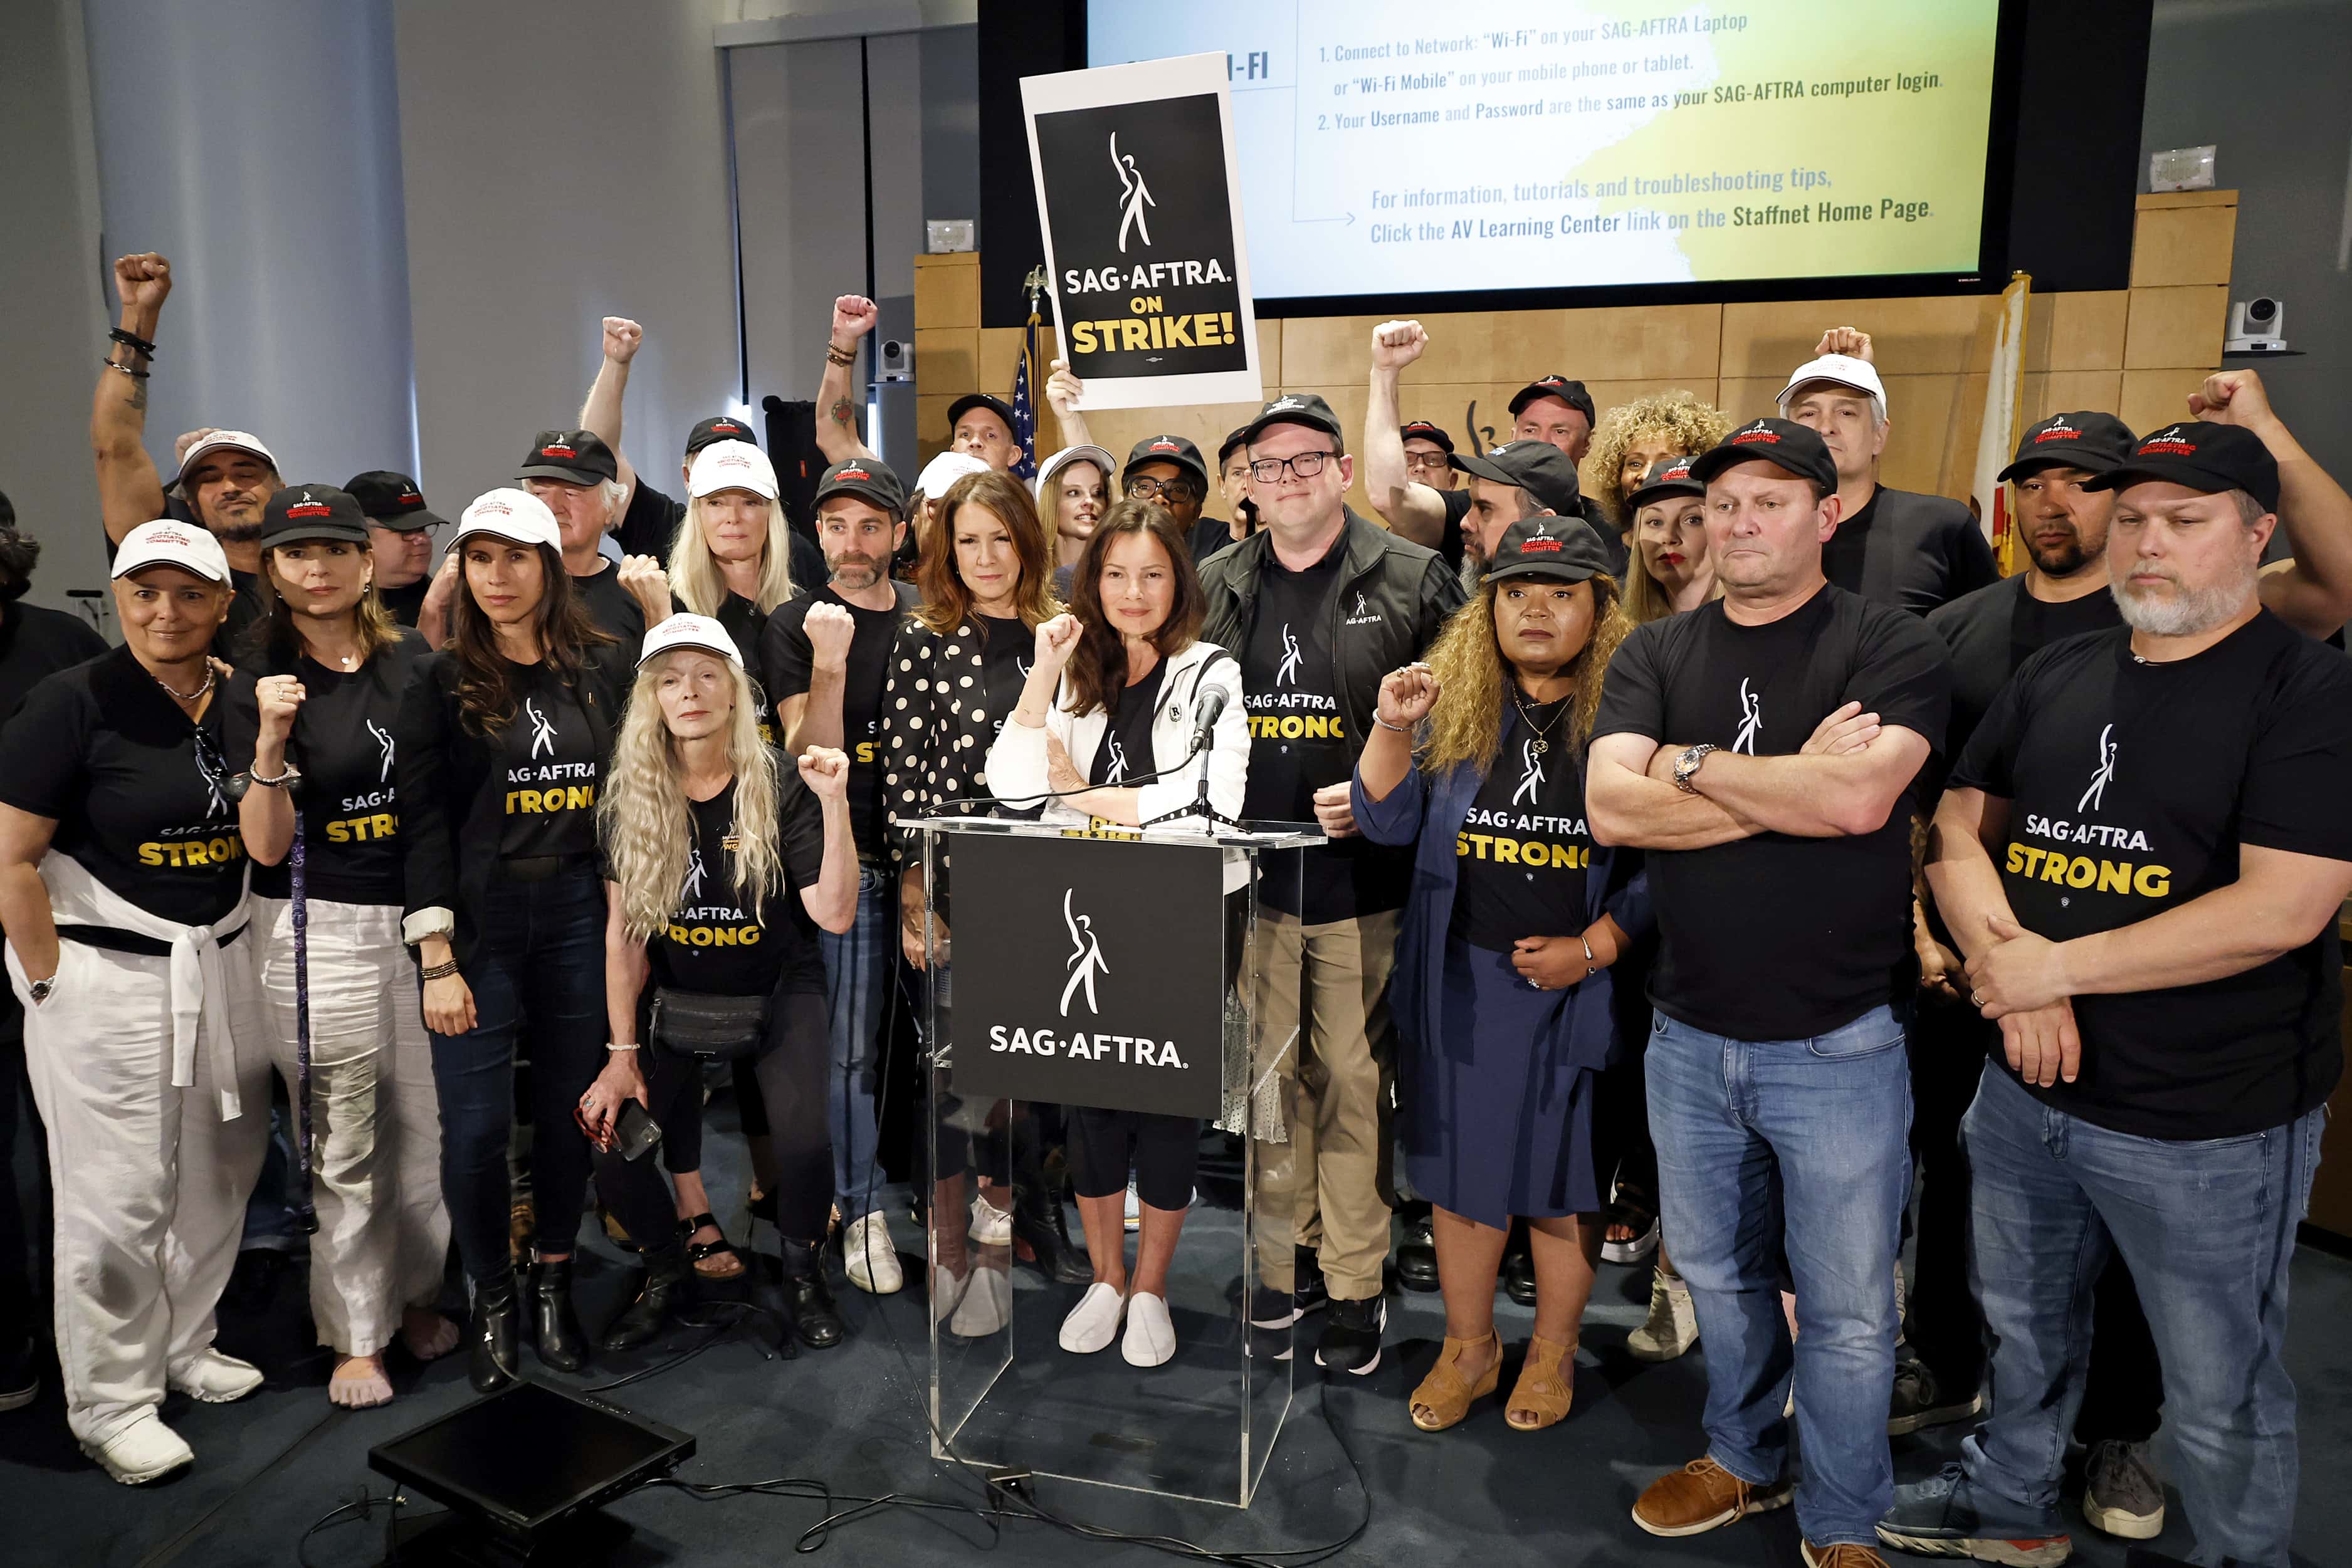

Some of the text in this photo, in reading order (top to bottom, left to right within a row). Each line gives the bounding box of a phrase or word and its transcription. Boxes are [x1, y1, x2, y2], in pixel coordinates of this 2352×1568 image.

[1319, 46, 1330, 63] 1.
[1335, 42, 1390, 62] Connect
[1396, 41, 1410, 56] to
[1414, 34, 1478, 56] Network:
[1540, 30, 1558, 46] on
[1563, 28, 1595, 47] your
[1601, 15, 1689, 40] SAG-AFTRA
[1694, 13, 1748, 34] Laptop
[1227, 51, 1268, 81] I-FI
[1334, 80, 1348, 96] or
[1459, 72, 1476, 86] on
[1481, 70, 1512, 88] your
[1518, 63, 1567, 82] mobile
[1572, 61, 1618, 81] phone
[1622, 58, 1639, 75] or
[1644, 53, 1694, 73] tablet.
[1318, 71, 1943, 131] 2. Your Username and Password are the same as your SAG-AFTRA computer login.
[1372, 166, 1832, 209] For information, tutorials and troubleshooting tips,
[1371, 198, 1935, 243] Click the AV Learning Center link on the Staffnet Home Page.
[1130, 295, 1163, 314] ON
[1071, 311, 1236, 353] STRIKE!
[1346, 614, 1382, 625] AG·AFTRA
[1172, 707, 1180, 716] R
[1247, 715, 1345, 739] TRONG
[508, 762, 596, 783] AG·AFTRA
[2006, 842, 2172, 897] STRONG
[668, 923, 760, 946] RONG
